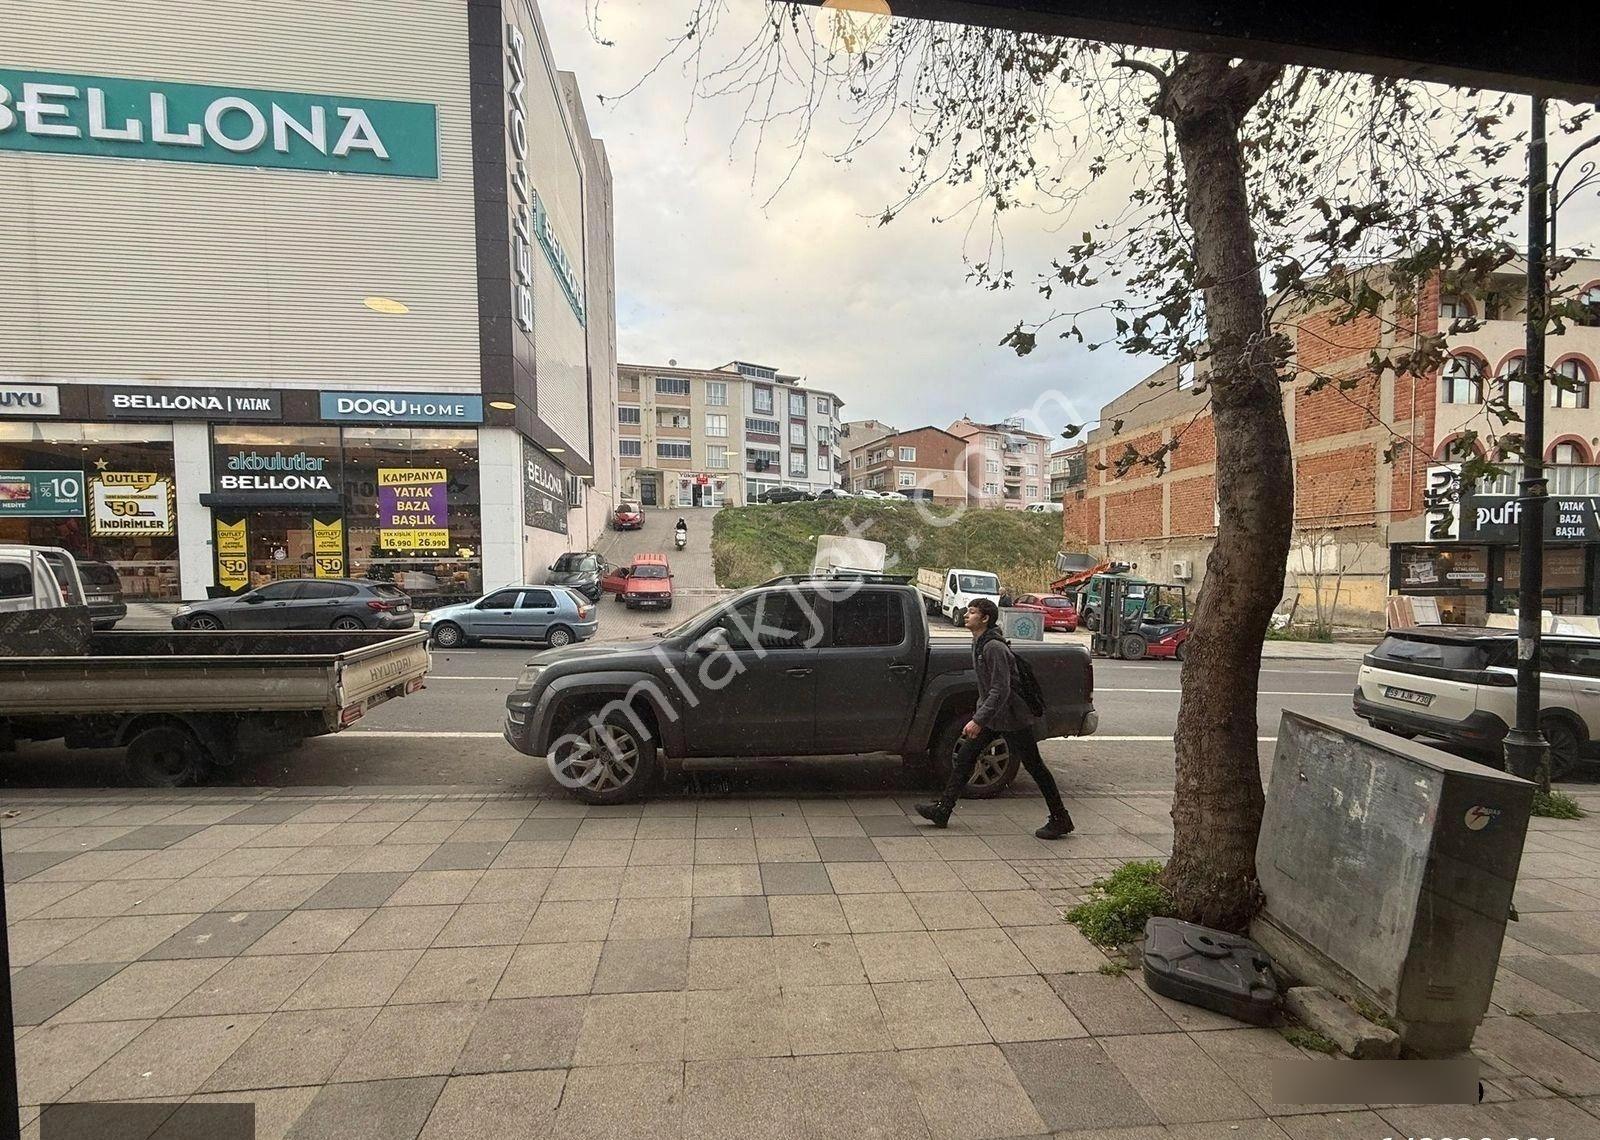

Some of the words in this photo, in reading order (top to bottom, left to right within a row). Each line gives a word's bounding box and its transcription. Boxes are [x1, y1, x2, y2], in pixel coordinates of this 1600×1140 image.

[507, 23, 534, 333] BELLONA
[112, 394, 224, 410] BELLONA
[235, 398, 271, 411] YATAK
[337, 398, 407, 417] DOQU
[410, 403, 465, 416] HOME
[227, 450, 326, 471] akbulutlar
[106, 474, 152, 483] OUTLET
[220, 475, 332, 490] BELLONA
[383, 471, 444, 483] KAMPANYA
[528, 460, 563, 496] BELLONA
[393, 487, 433, 497] YATAK
[396, 501, 431, 511] BAZA
[1558, 501, 1585, 511] YATAK
[392, 515, 436, 527] BAŞLIK
[1476, 501, 1522, 531] puff
[1559, 514, 1583, 524] BAZA
[100, 518, 165, 529] İNDİRİMLER
[1555, 527, 1586, 538] BAŞLIK
[384, 538, 412, 547] 16.990
[418, 538, 446, 547] 26.990
[369, 656, 411, 680] HYUNDAI
